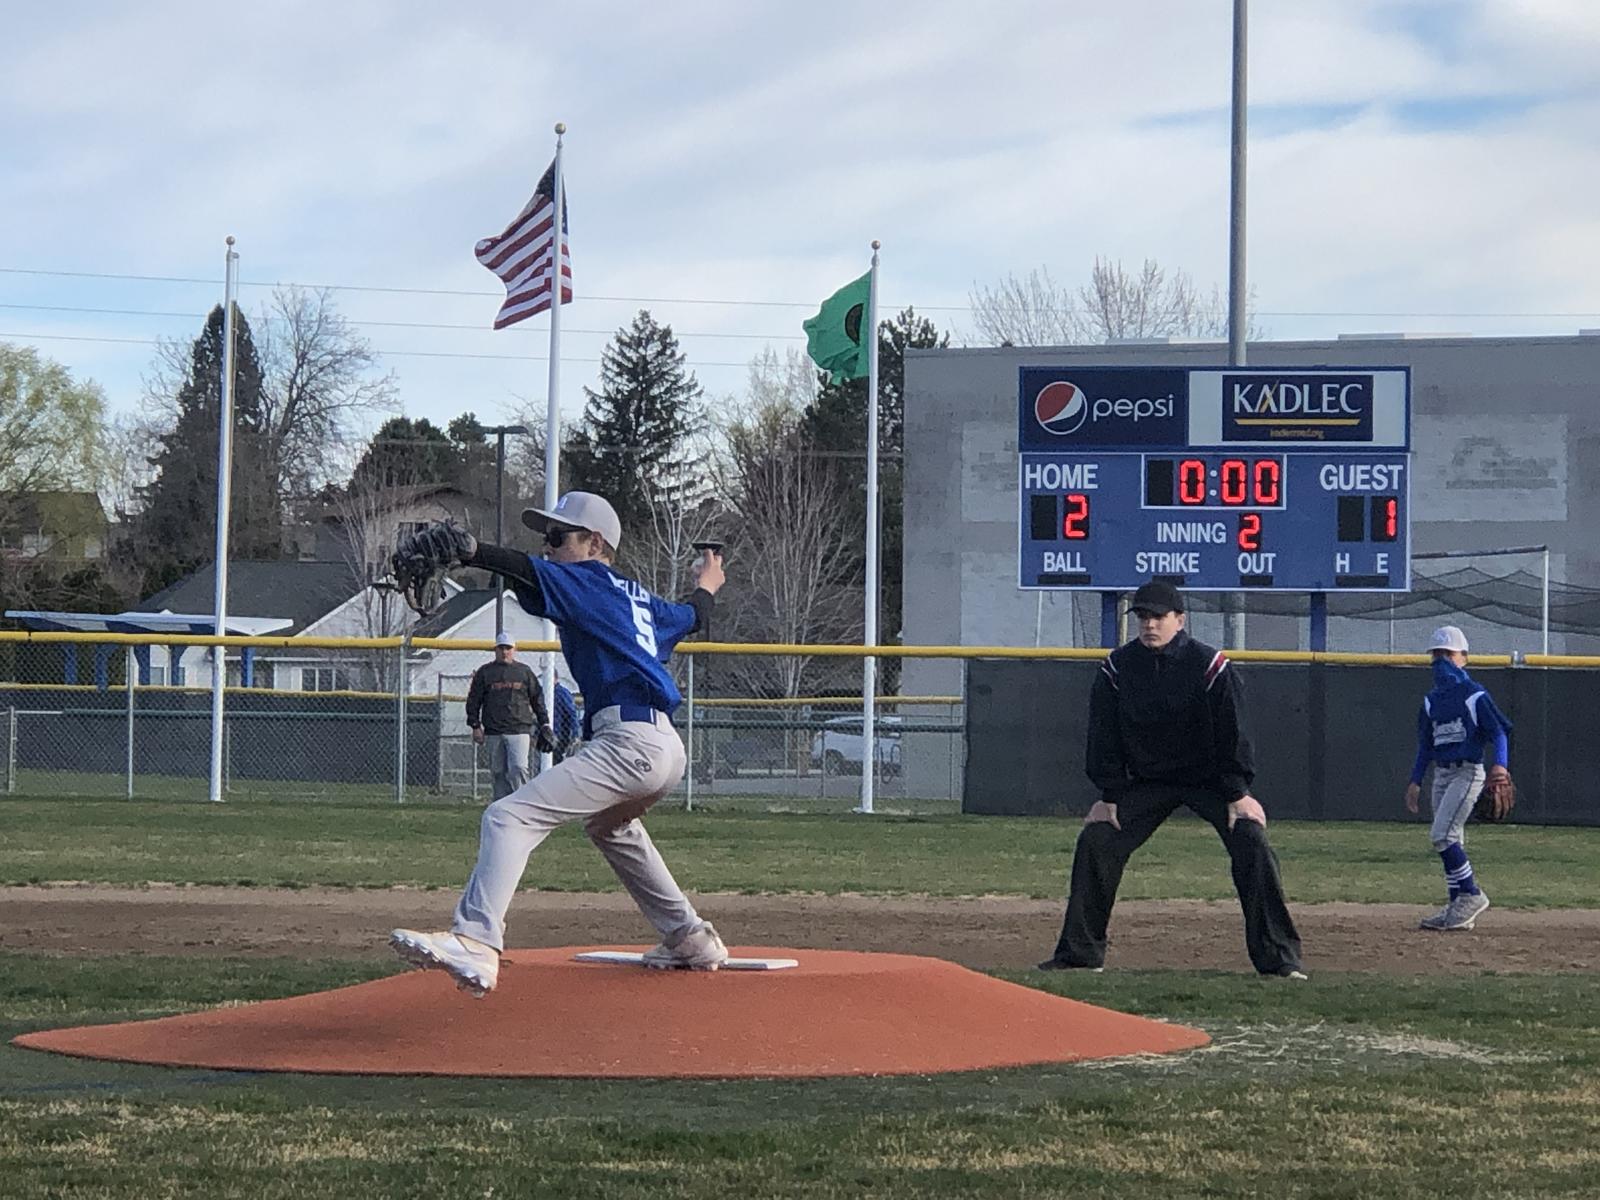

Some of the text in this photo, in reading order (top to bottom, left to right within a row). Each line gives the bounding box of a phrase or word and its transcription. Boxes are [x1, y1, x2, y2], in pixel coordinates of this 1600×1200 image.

[1092, 394, 1174, 421] pepsi
[1233, 383, 1363, 413] KADLEC
[1026, 464, 1097, 489] HOME
[1179, 460, 1279, 505] 0:00
[1320, 465, 1403, 490] GUEST
[1064, 494, 1088, 538] 2
[1386, 500, 1396, 536] 1
[1158, 514, 1260, 550] INNING 2
[1044, 552, 1086, 571] BALL
[1136, 552, 1199, 572] STRIKE
[1238, 553, 1275, 573] OUT
[1337, 553, 1388, 573] H E
